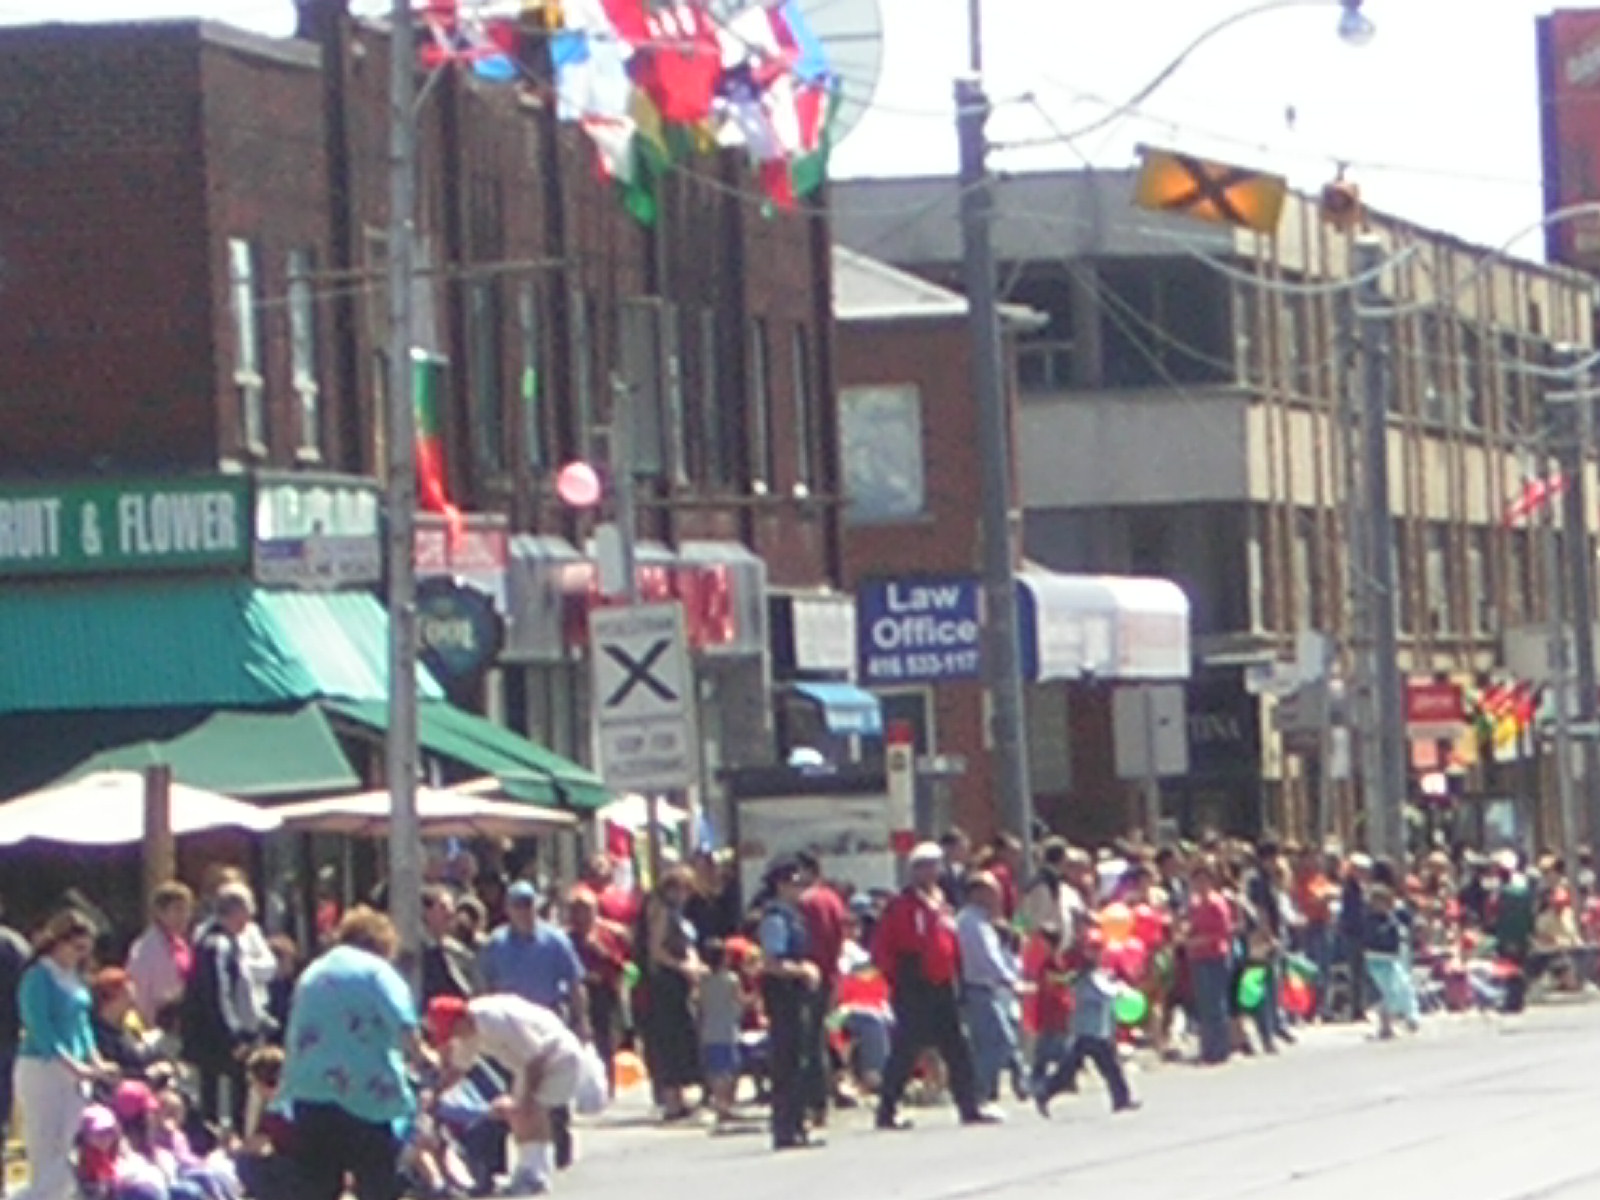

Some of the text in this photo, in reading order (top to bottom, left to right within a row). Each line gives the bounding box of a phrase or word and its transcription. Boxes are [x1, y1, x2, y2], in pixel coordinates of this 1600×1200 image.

[82, 501, 101, 557] &
[119, 491, 238, 554] FLOWER
[886, 582, 959, 612] Law
[872, 615, 977, 649] Office
